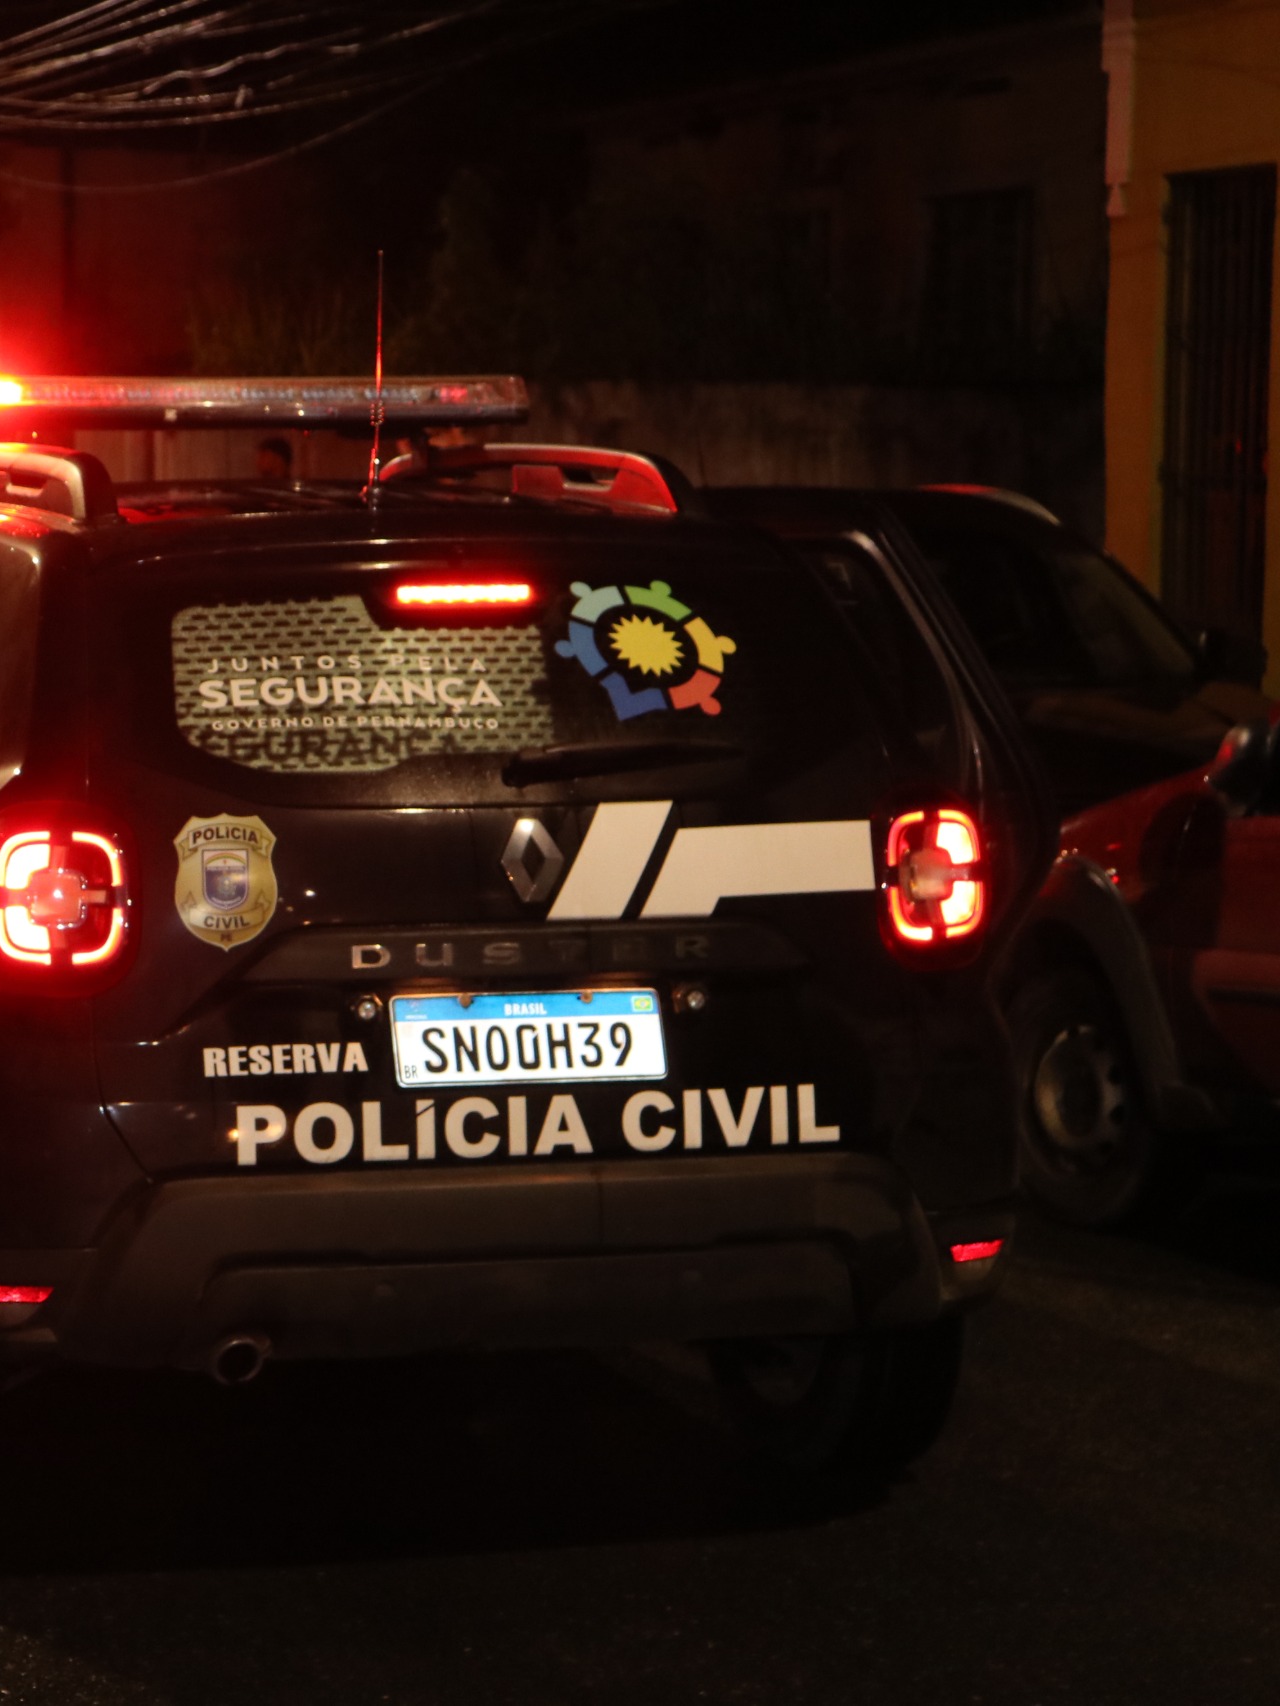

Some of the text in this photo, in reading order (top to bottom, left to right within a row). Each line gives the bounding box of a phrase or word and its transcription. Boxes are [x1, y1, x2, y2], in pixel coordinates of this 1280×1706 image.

[207, 654, 486, 674] JUNTOS PELA
[198, 676, 503, 714] SEGURANÇA
[212, 716, 498, 731] GOVERNO DE PERNAMBUCO
[204, 915, 251, 929] CIVIL
[351, 935, 709, 969] DUSTER
[504, 1002, 547, 1017] BRASIL
[203, 1042, 368, 1078] RESERVA
[404, 1065, 418, 1079] BR
[235, 1083, 840, 1167] POLÍCIA CIVIL
